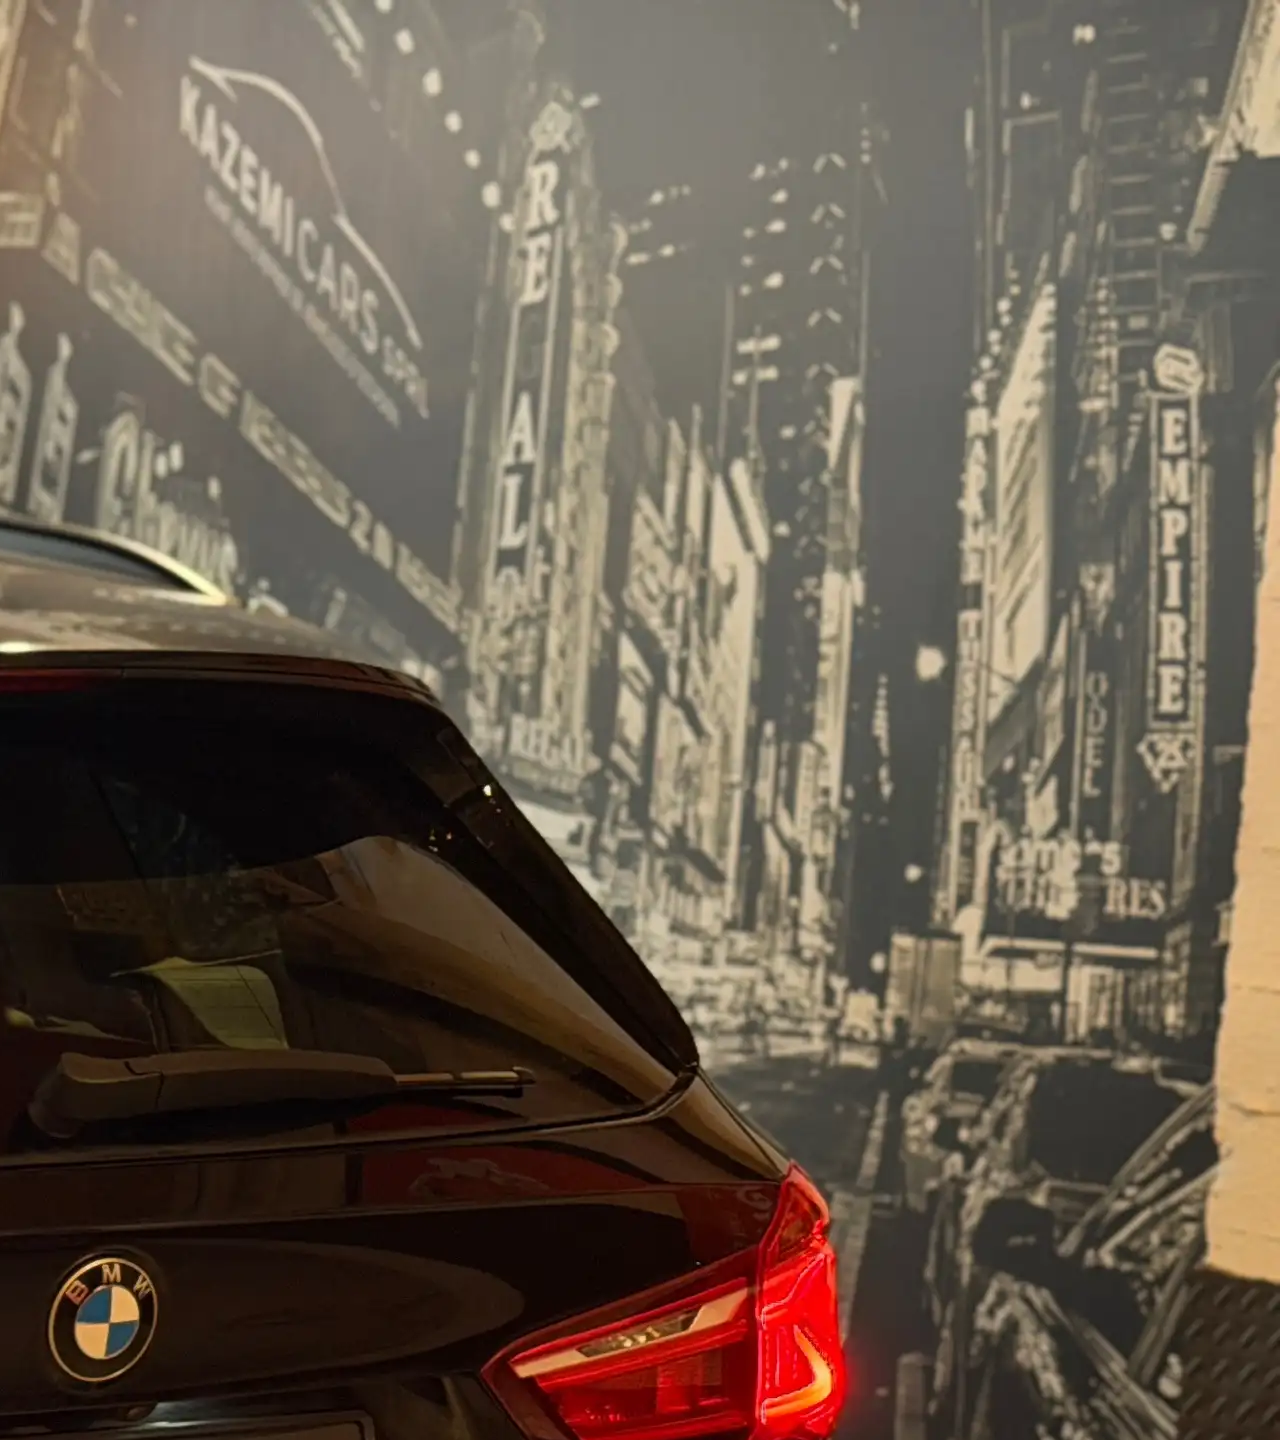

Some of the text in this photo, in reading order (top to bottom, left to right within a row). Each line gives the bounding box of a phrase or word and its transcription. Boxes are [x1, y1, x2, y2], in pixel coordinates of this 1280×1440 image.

[179, 75, 379, 355] KAZEMICARS
[1156, 407, 1192, 714] EMPIRE
[64, 1263, 153, 1306] BMW
